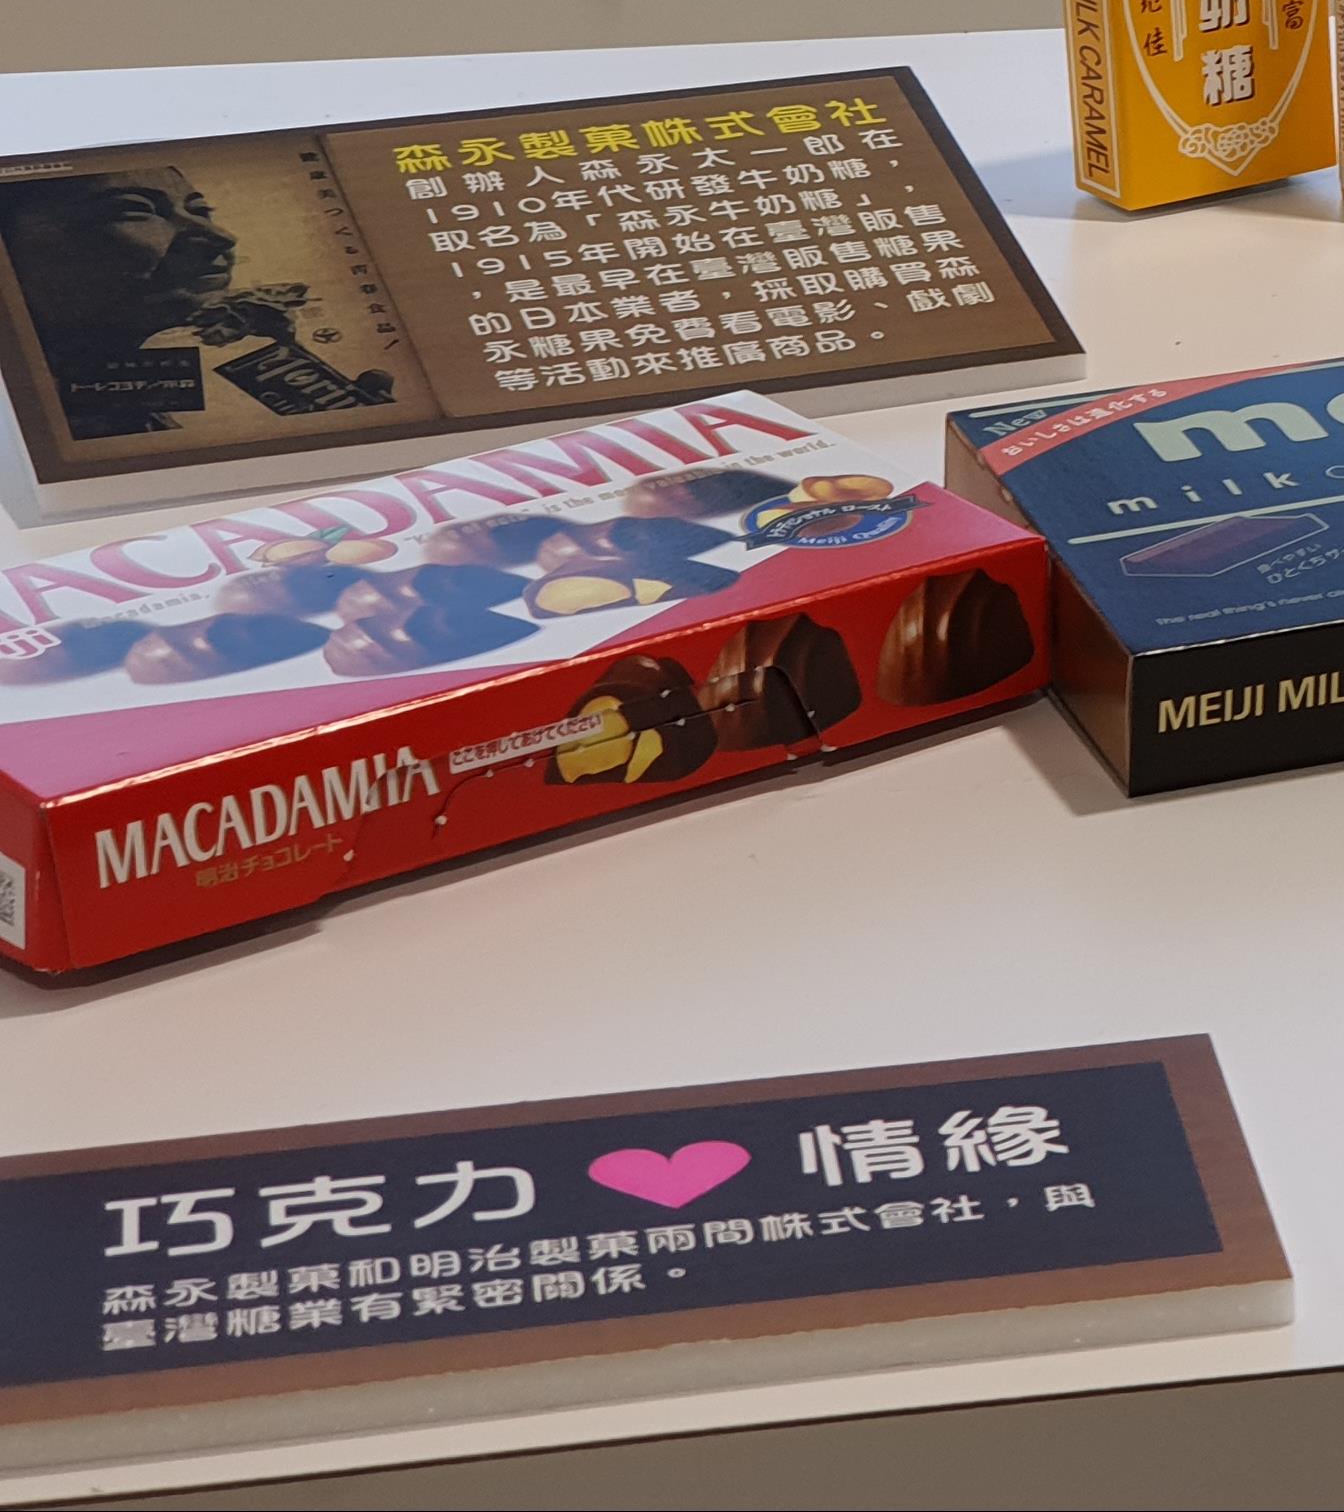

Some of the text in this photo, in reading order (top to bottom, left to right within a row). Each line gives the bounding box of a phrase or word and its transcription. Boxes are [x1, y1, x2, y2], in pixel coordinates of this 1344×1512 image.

[393, 97, 888, 174] 森永製菓株式會社
[1077, 44, 1110, 178] CARAMEL
[406, 128, 903, 200] 創辦人森永太一郎在
[451, 204, 946, 278] 1915年開始在臺灣販售
[983, 409, 1047, 436] New
[1106, 470, 1303, 517] milk
[1157, 686, 1265, 734] MEIJI
[95, 746, 440, 888] MACADAMIA
[102, 1102, 1069, 1257] 巧克力 情緣
[101, 1263, 691, 1354] 臺灣糖業有緊密關係。
